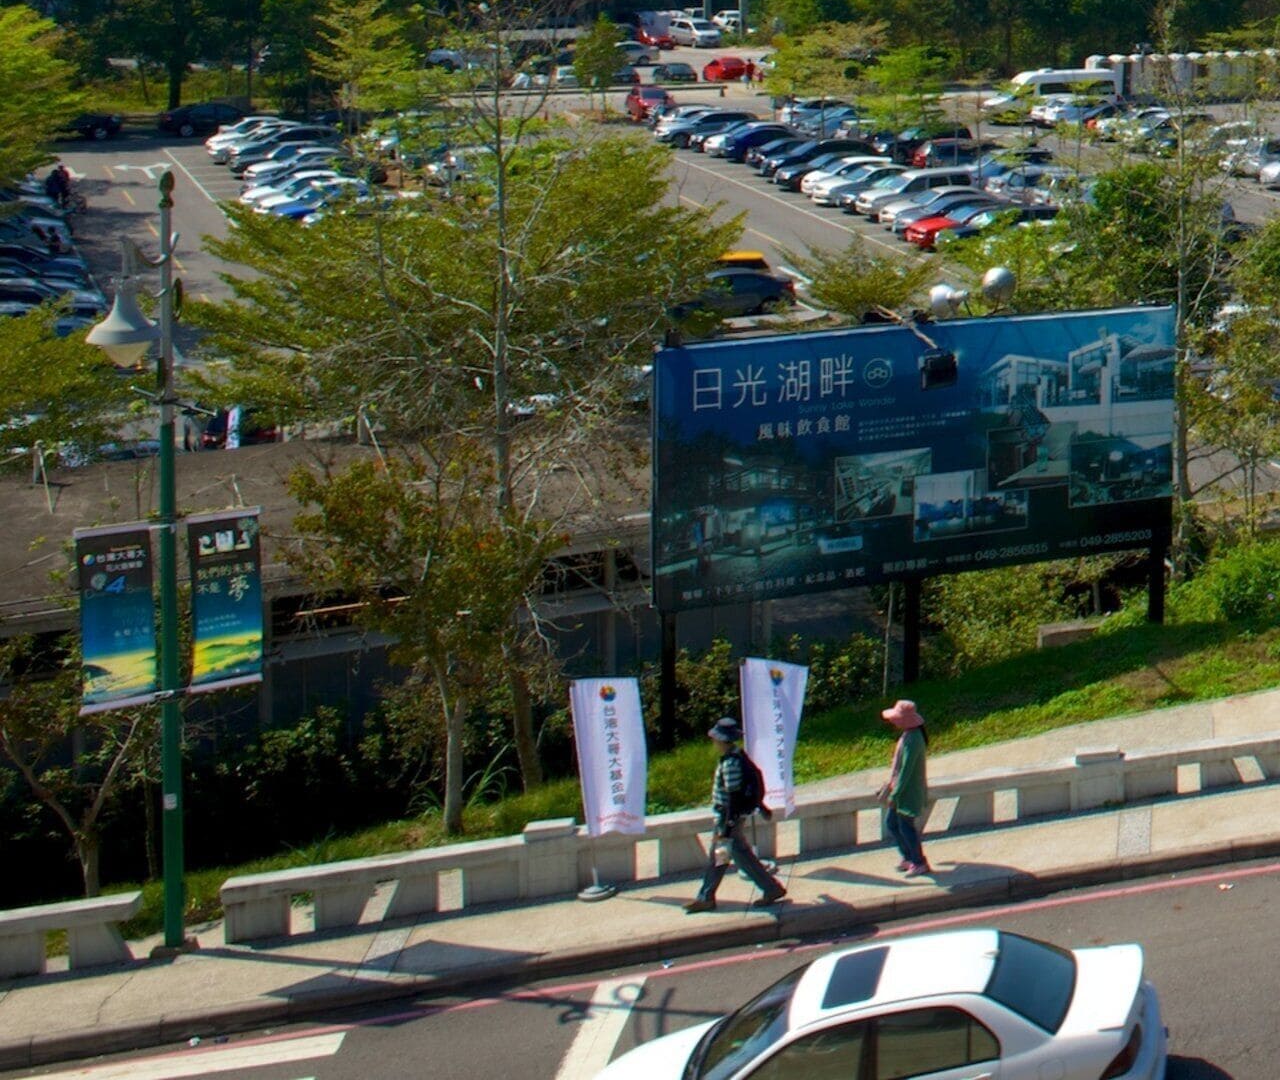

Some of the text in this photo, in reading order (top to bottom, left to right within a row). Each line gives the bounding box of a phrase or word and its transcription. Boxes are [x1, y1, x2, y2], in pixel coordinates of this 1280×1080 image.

[692, 353, 854, 412] 日光湖畔
[799, 396, 897, 415] Sunny Lake Wonder
[758, 415, 850, 441] 風味飲食館
[603, 705, 626, 806] 台灣大哥大基金會
